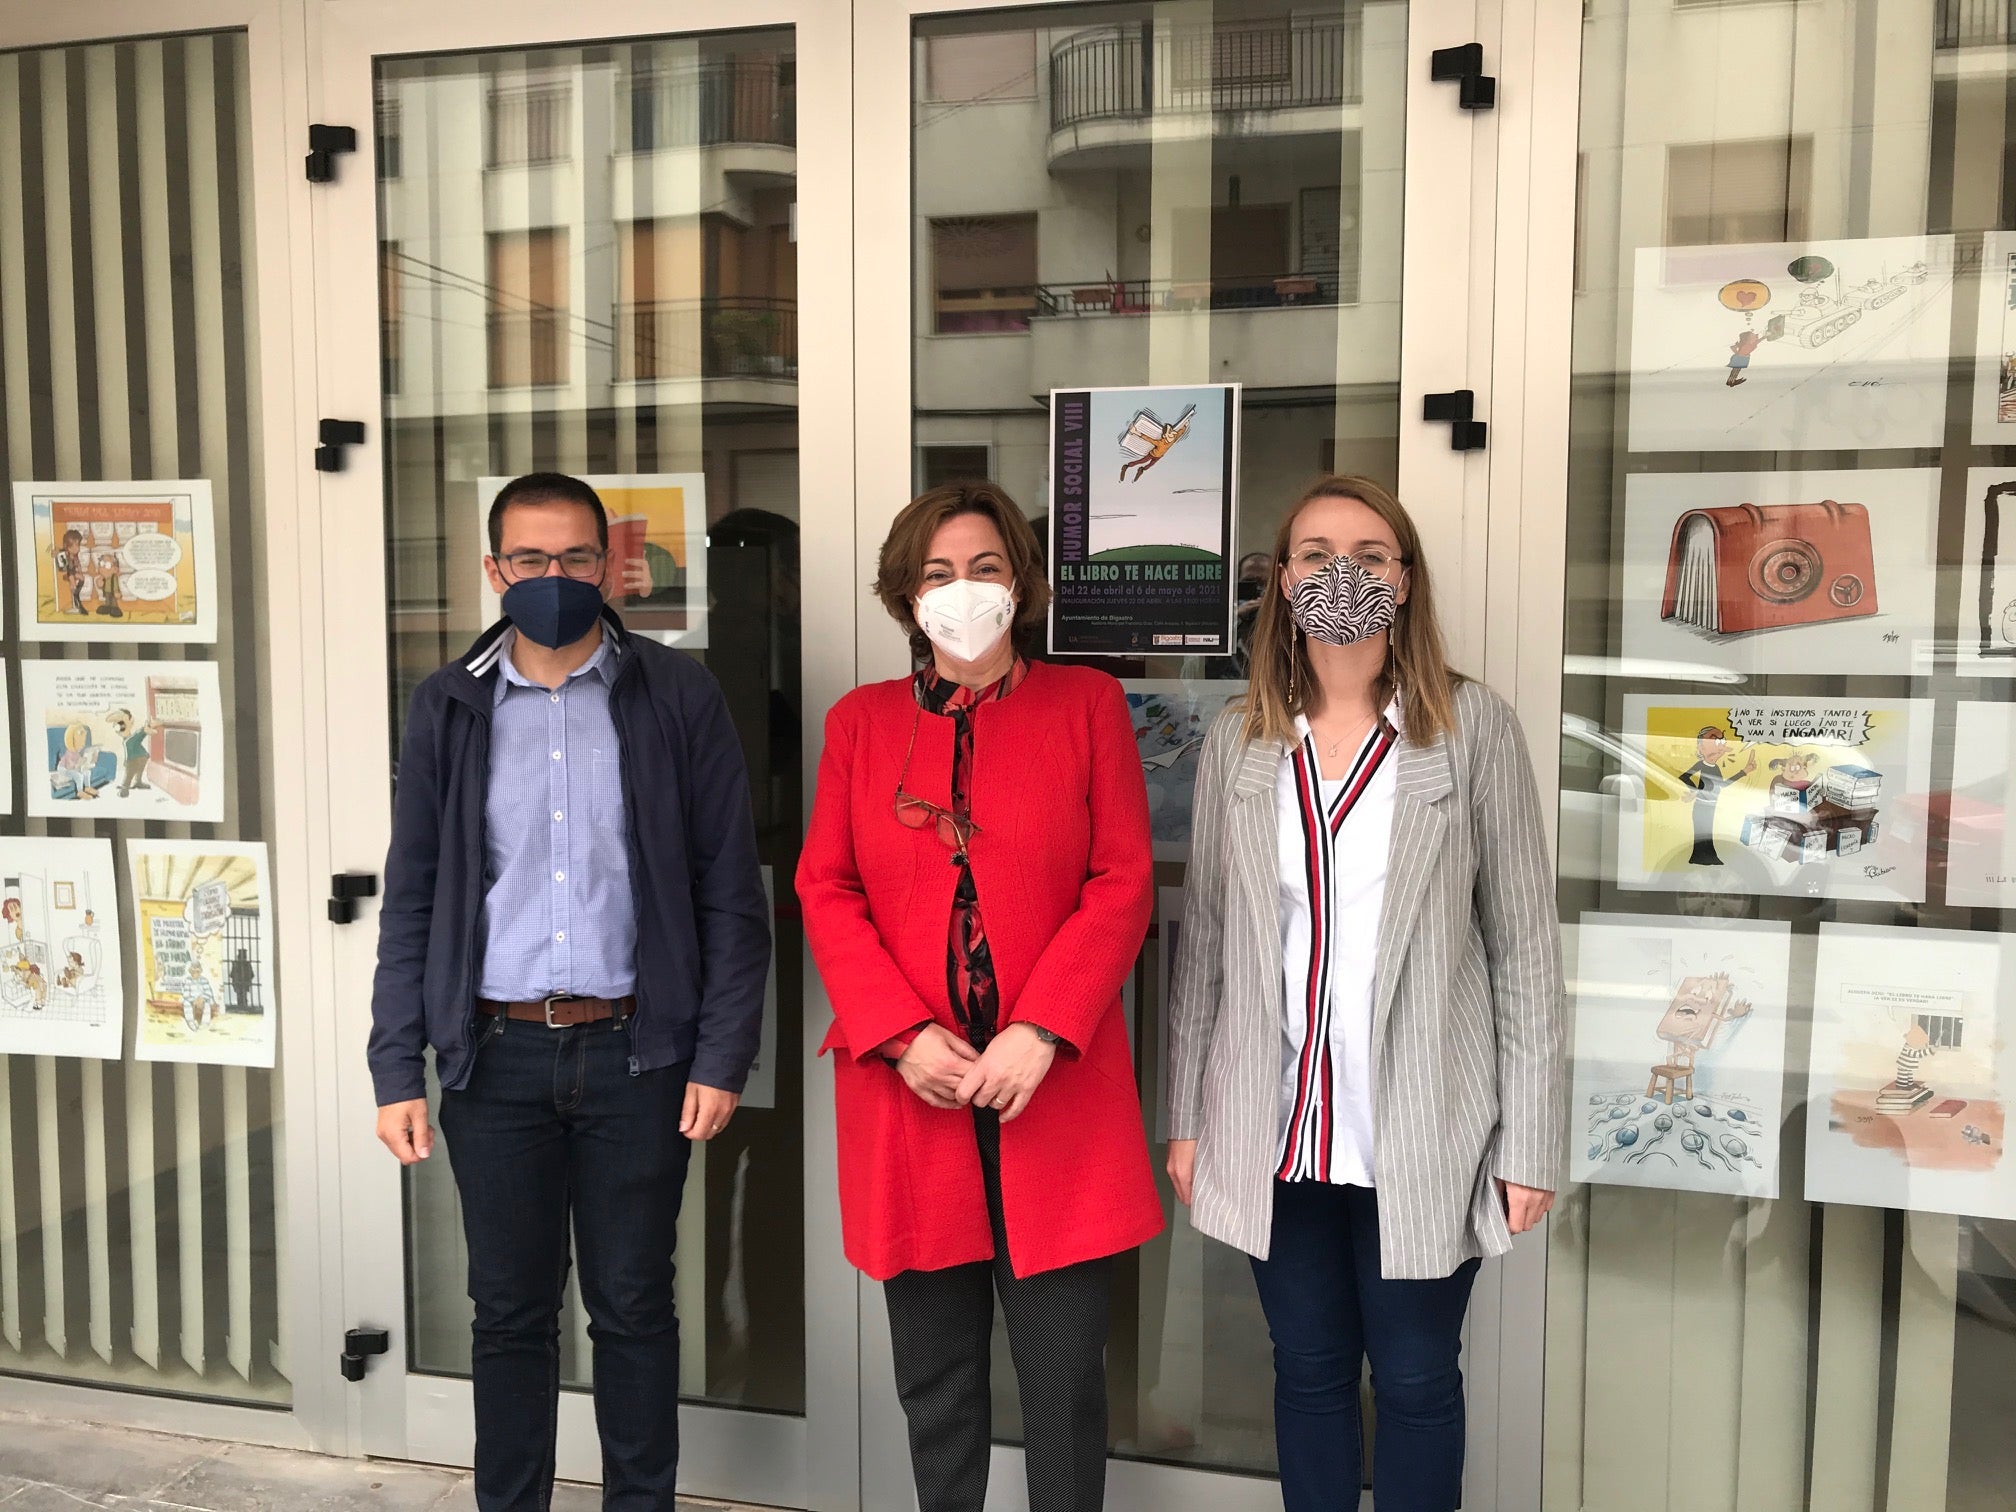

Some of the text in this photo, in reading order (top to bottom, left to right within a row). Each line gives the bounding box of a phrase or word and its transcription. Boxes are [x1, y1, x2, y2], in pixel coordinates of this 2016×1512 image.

[1063, 402, 1084, 562] HUMOR SOCIAL VIII
[1060, 564, 1222, 581] EL LIBRO TE HACE LIBRE
[1062, 584, 1220, 597] Del 22 de abril al 6 de mayo de 2021
[1734, 708, 1750, 717] ¡NO
[1770, 709, 1816, 717] INSTRUYAS
[1824, 710, 1858, 718] TANTO!
[1818, 718, 1838, 726] ¡NO
[1782, 727, 1852, 741] ENGAÑAR!
